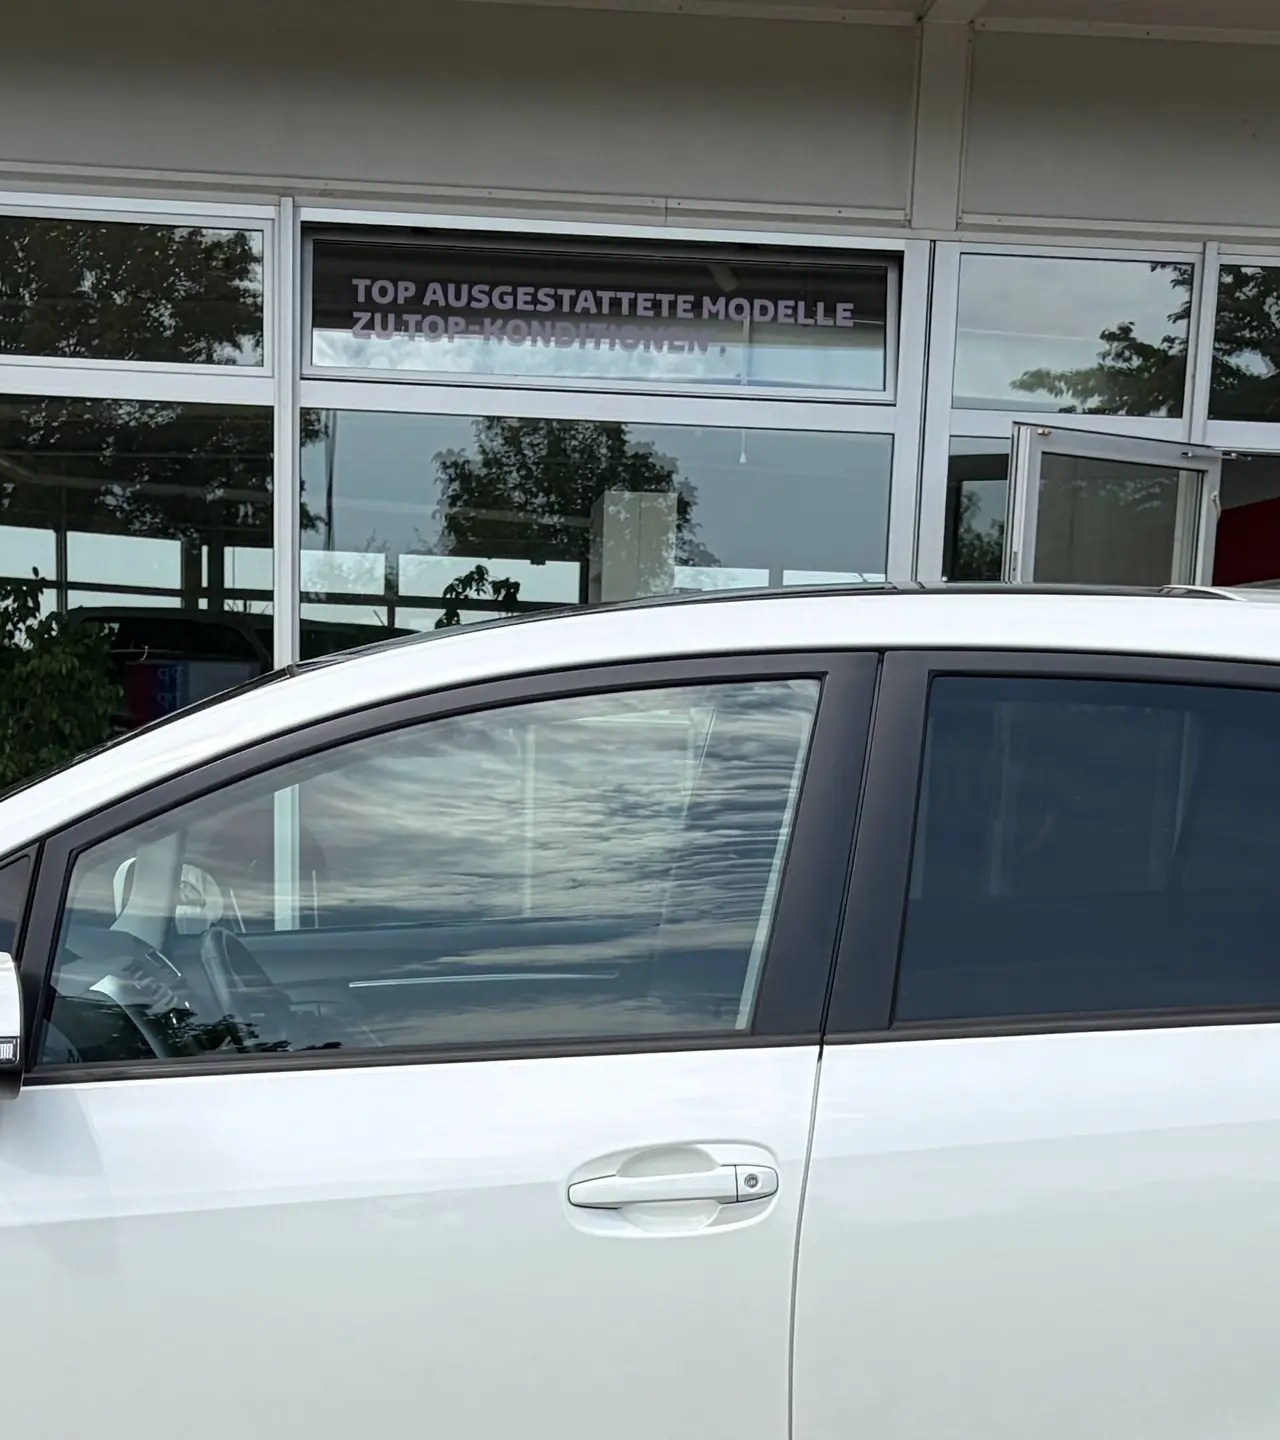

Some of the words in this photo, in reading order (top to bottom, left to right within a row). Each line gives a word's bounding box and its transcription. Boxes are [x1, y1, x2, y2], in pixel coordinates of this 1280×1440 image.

[352, 278, 416, 305] TOP
[422, 281, 695, 320] AUSGESTATTETE
[702, 295, 855, 328] MODELLE
[352, 311, 395, 340] ZU
